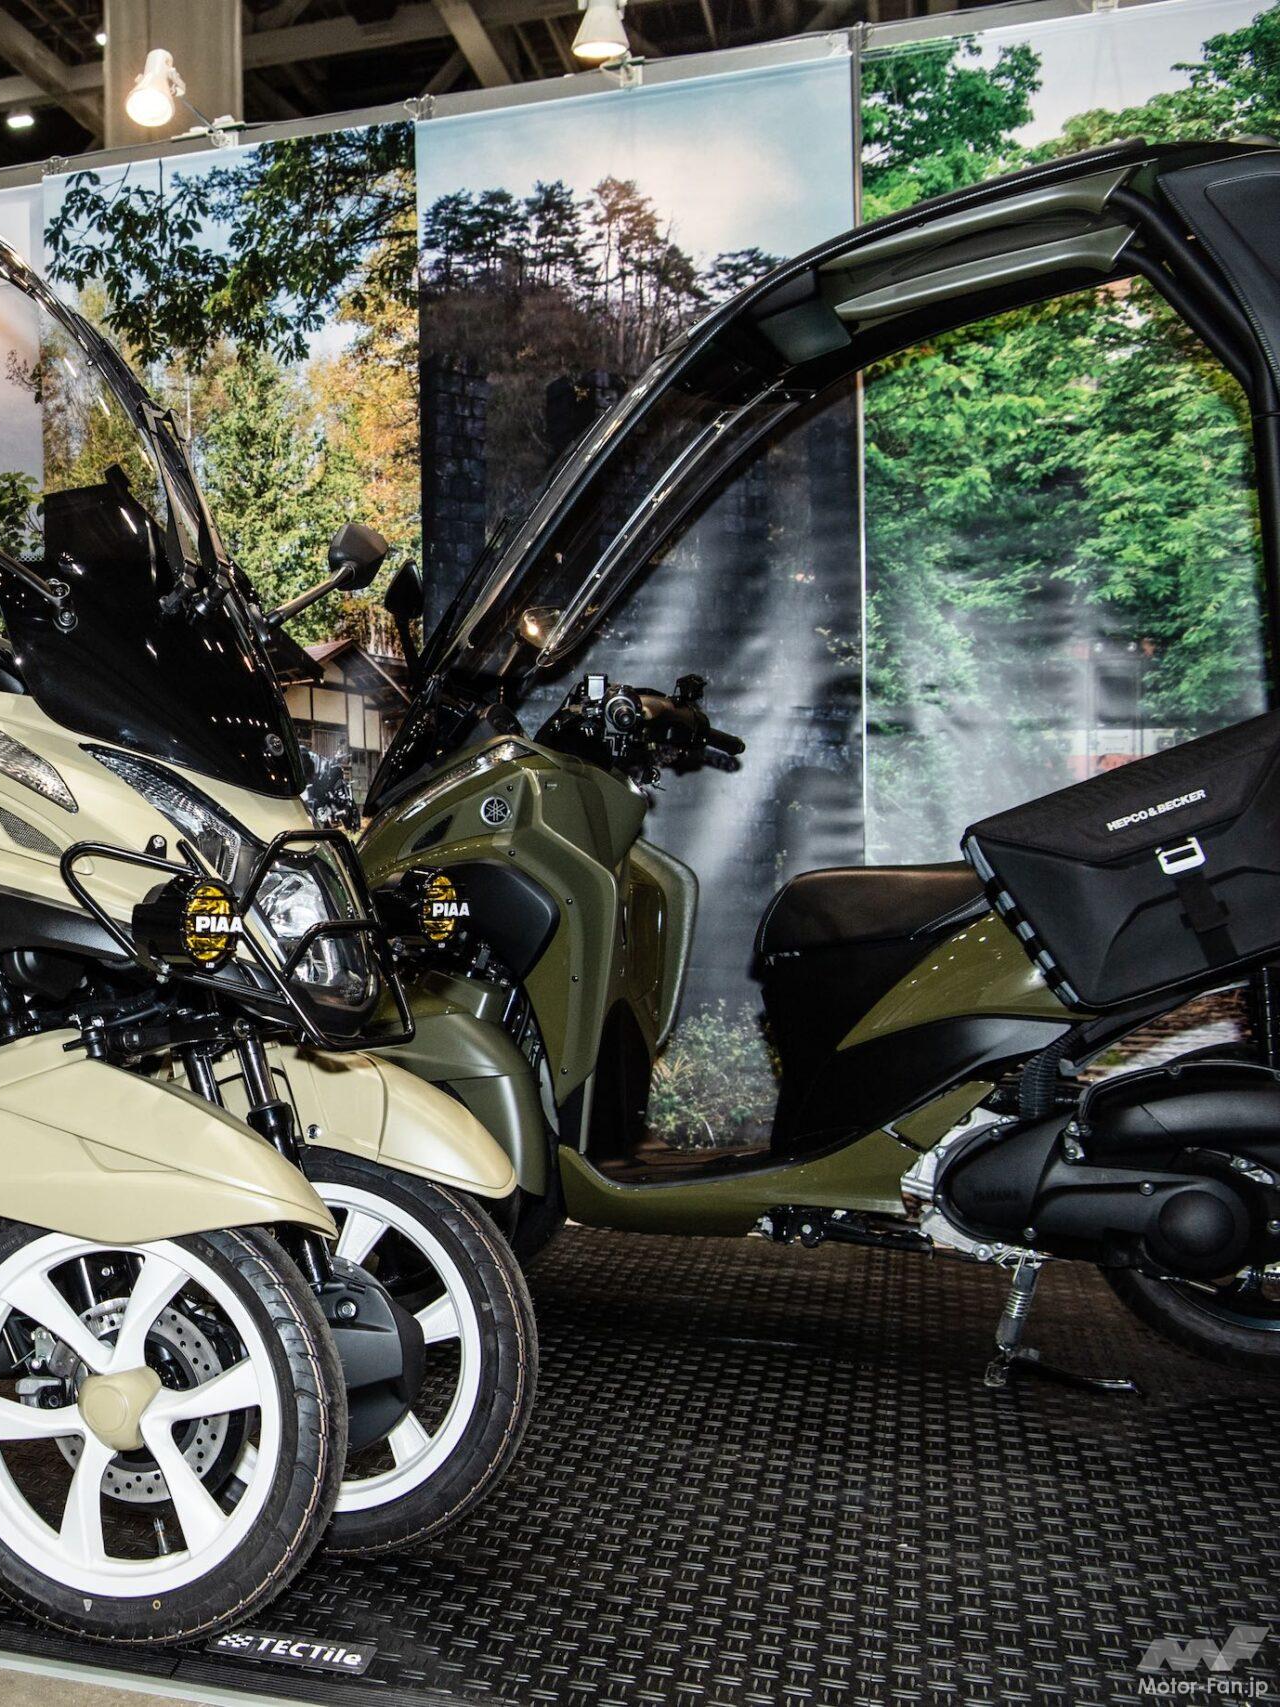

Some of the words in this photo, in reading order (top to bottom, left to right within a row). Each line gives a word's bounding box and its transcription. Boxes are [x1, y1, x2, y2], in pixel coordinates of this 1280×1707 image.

[1105, 810, 1149, 831] HEPCO
[1156, 789, 1207, 814] BECKER
[432, 902, 470, 917] PIAA
[195, 916, 244, 933] PIAA
[256, 1636, 363, 1666] TECTile
